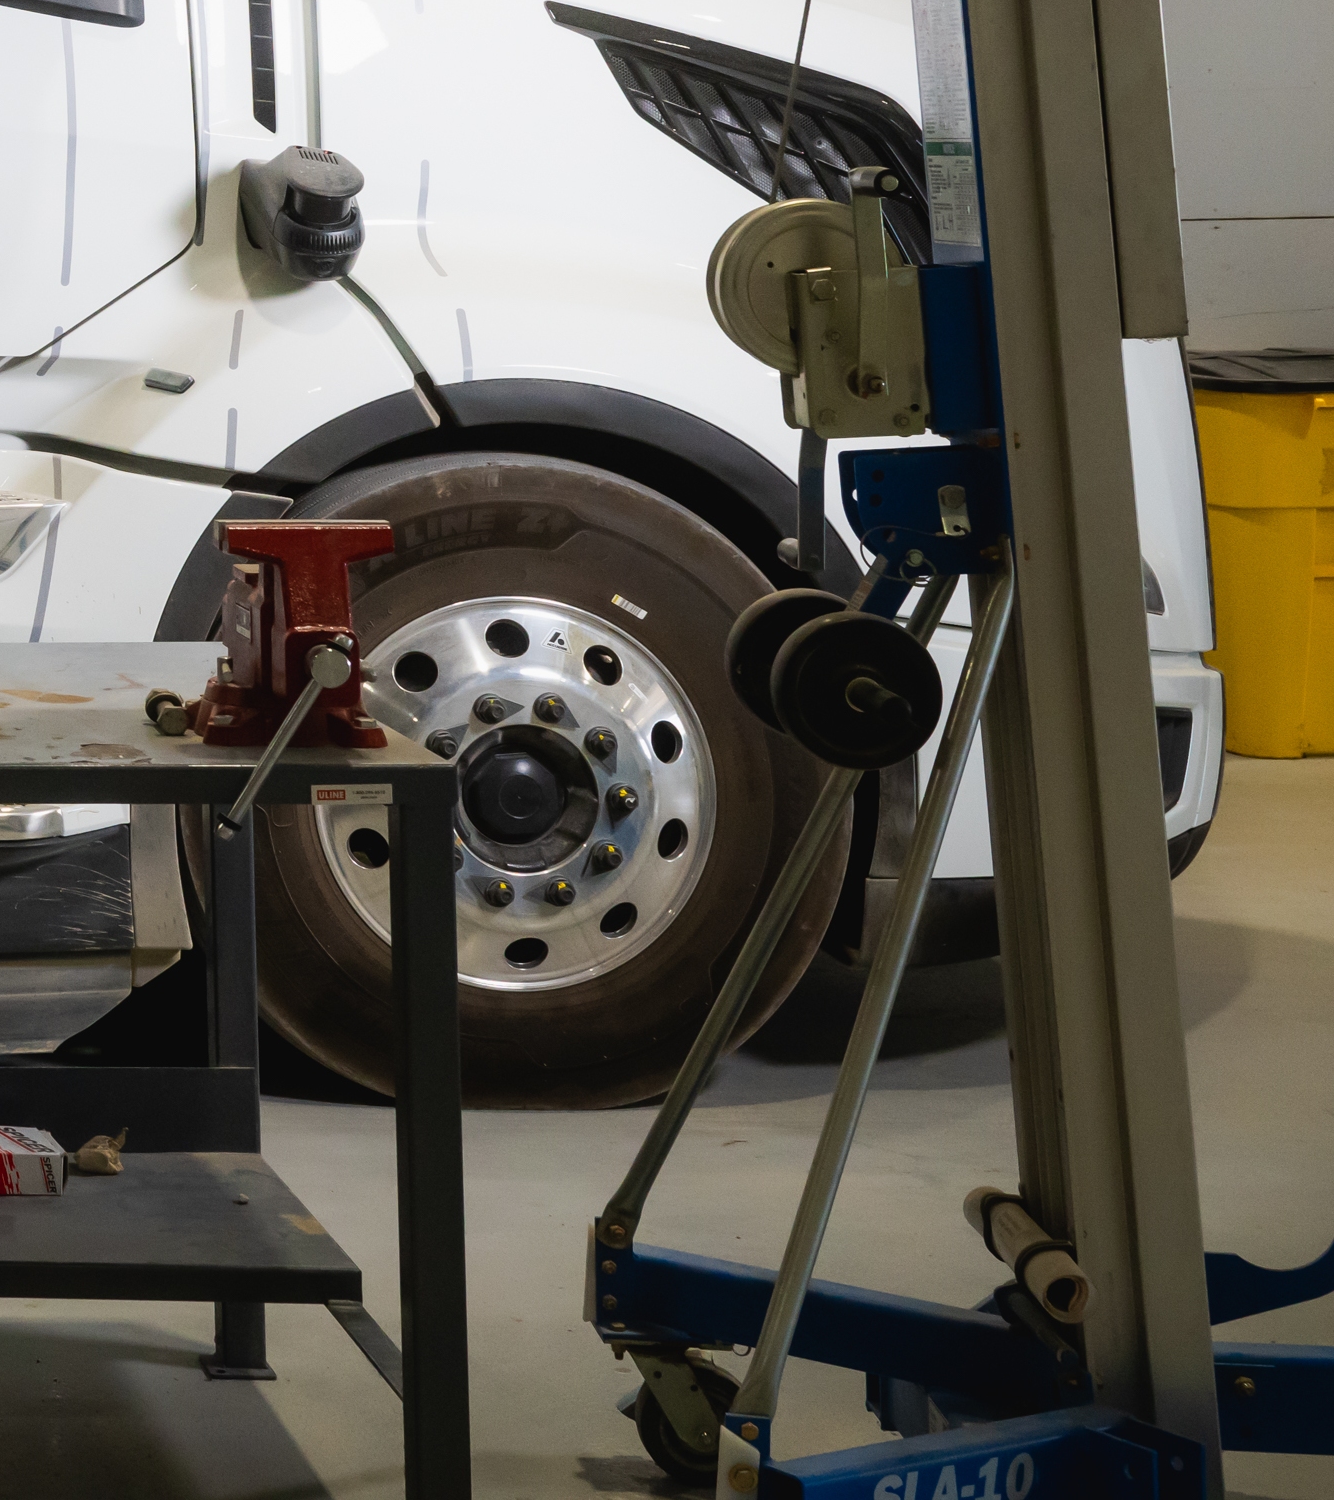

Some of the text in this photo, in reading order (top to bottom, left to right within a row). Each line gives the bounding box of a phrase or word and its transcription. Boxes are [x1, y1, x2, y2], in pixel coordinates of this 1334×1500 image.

[404, 507, 496, 548] LINE
[318, 791, 345, 800] ULINE
[42, 1156, 58, 1194] SPICER
